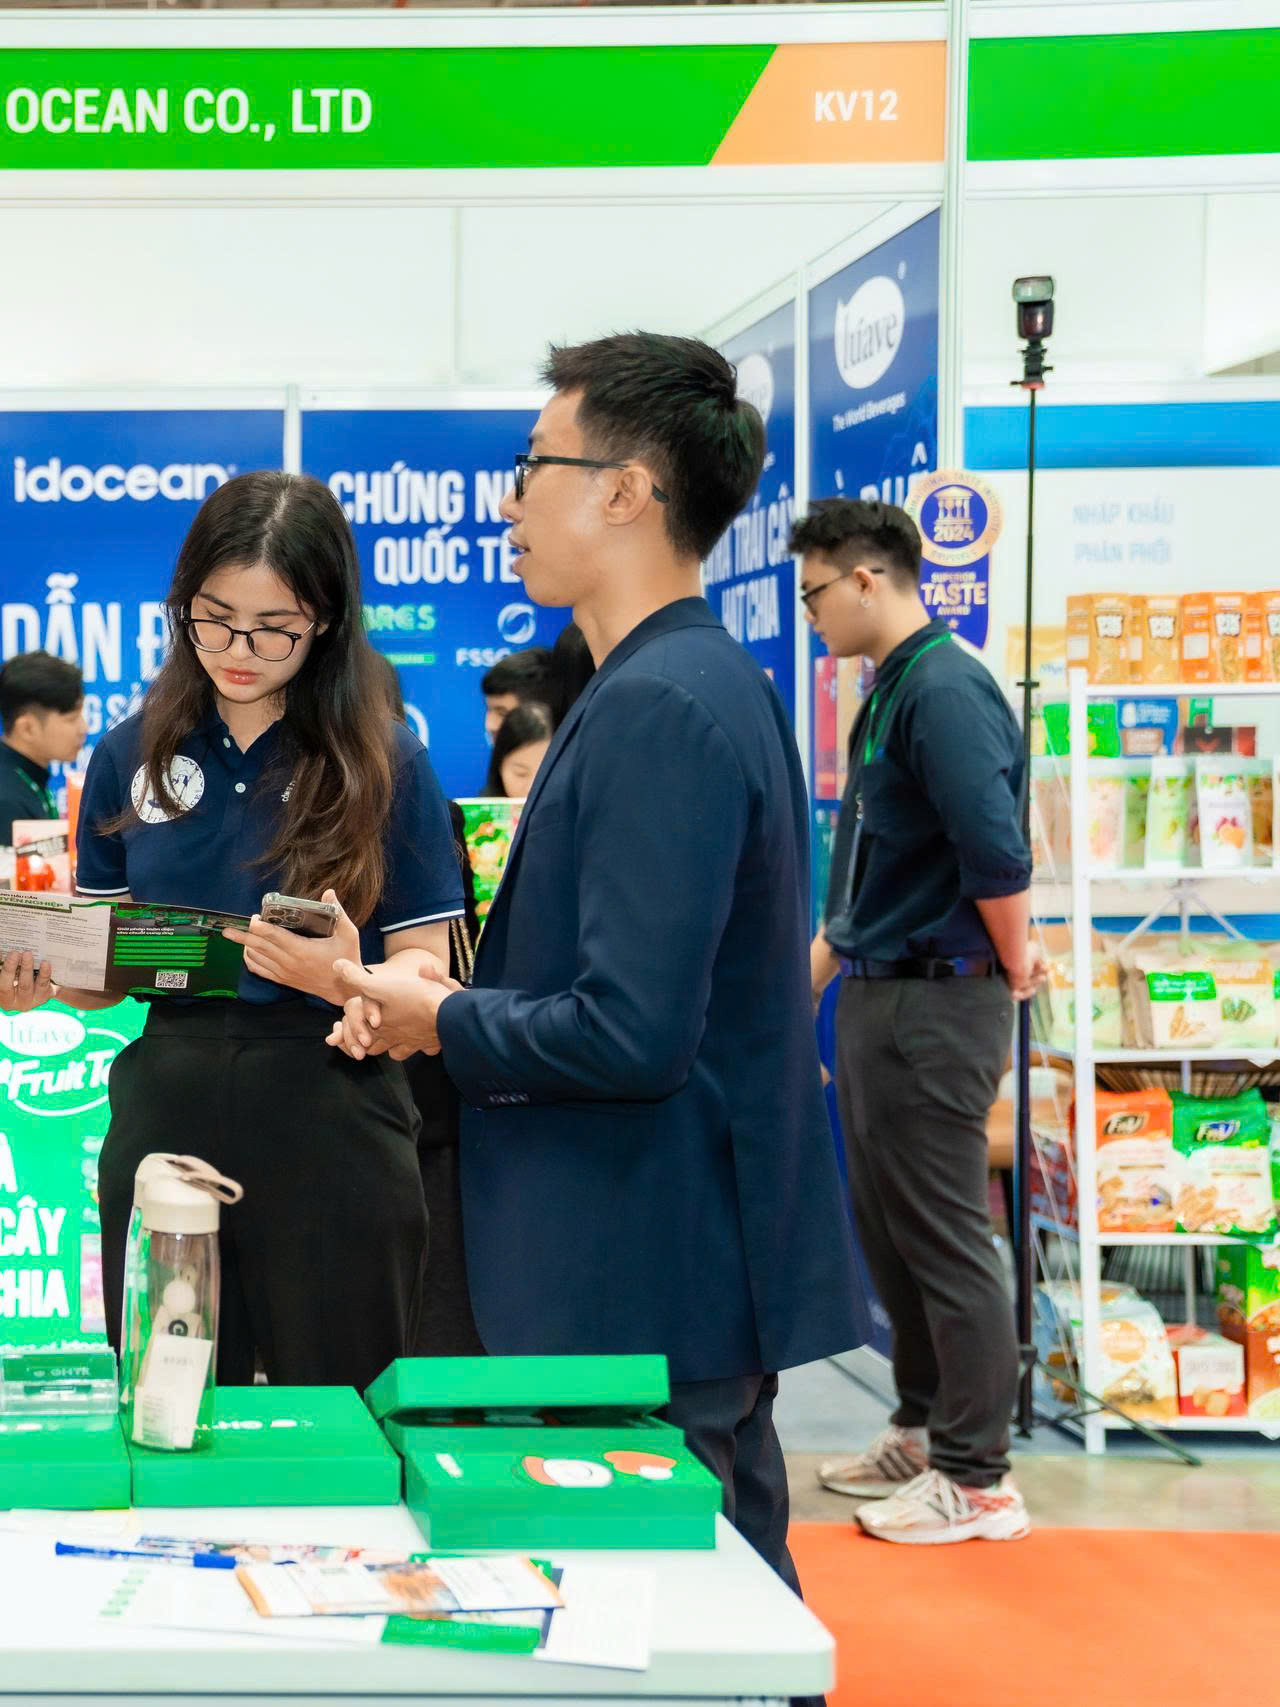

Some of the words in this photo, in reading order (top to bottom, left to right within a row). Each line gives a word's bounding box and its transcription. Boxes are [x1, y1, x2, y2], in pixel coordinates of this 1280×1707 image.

[5, 87, 168, 134] OCEAN
[183, 87, 276, 141] CO.,
[292, 88, 372, 133] LTD
[814, 89, 899, 122] KV12
[14, 456, 227, 503] idocean
[327, 460, 465, 525] CHỨNG
[374, 523, 469, 586] QUỐC
[921, 581, 988, 606] TASTE
